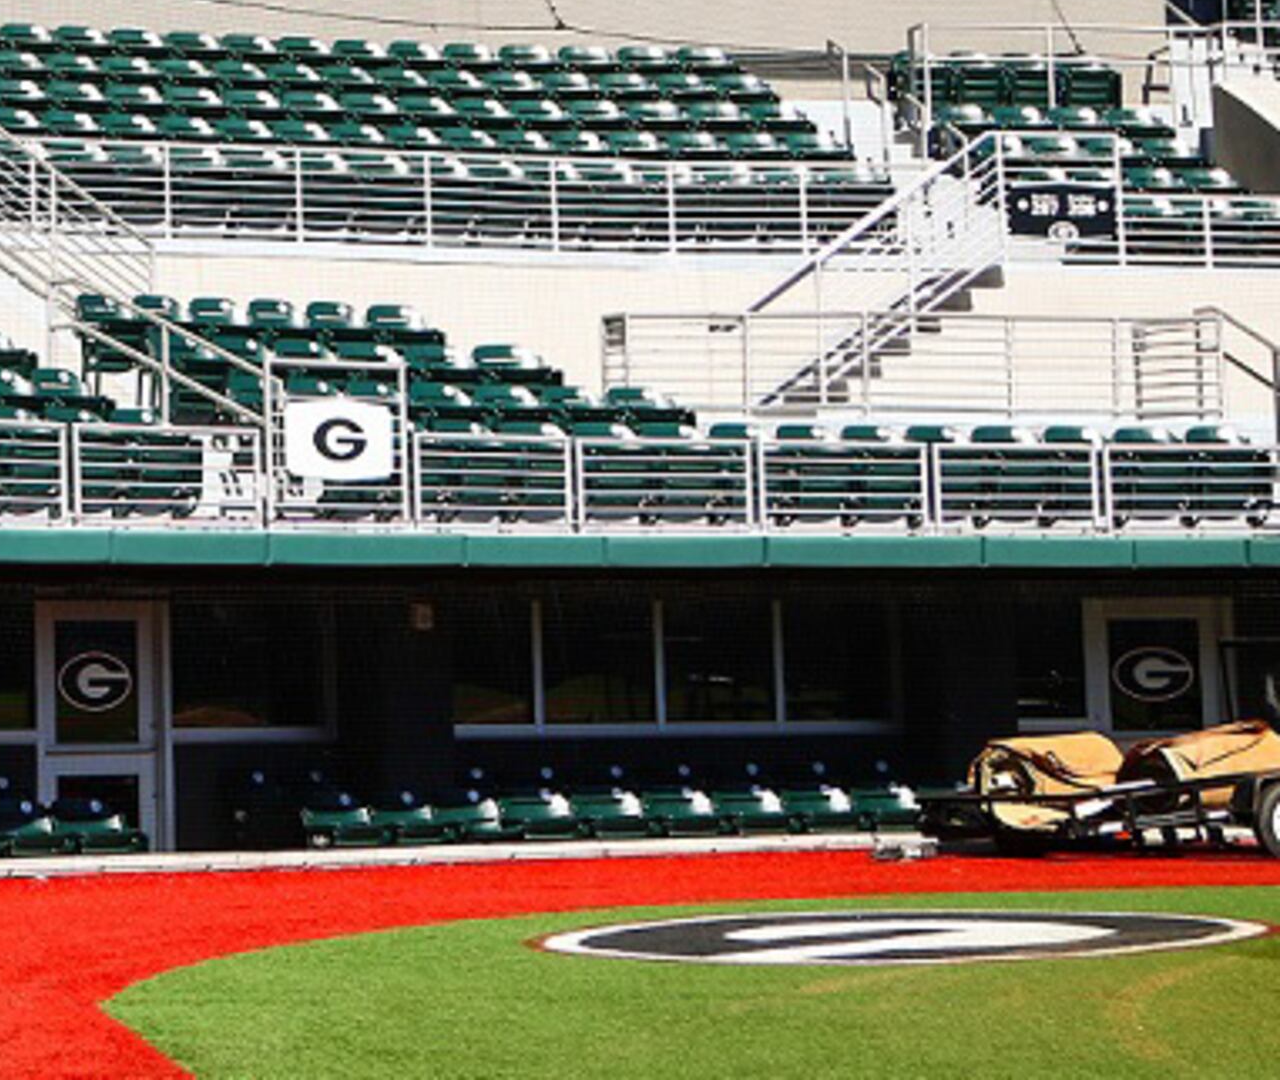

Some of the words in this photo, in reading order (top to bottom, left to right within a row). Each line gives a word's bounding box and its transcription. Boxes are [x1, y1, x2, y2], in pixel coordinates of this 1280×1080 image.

[313, 418, 367, 461] G
[58, 652, 132, 712] G
[1112, 647, 1193, 701] G
